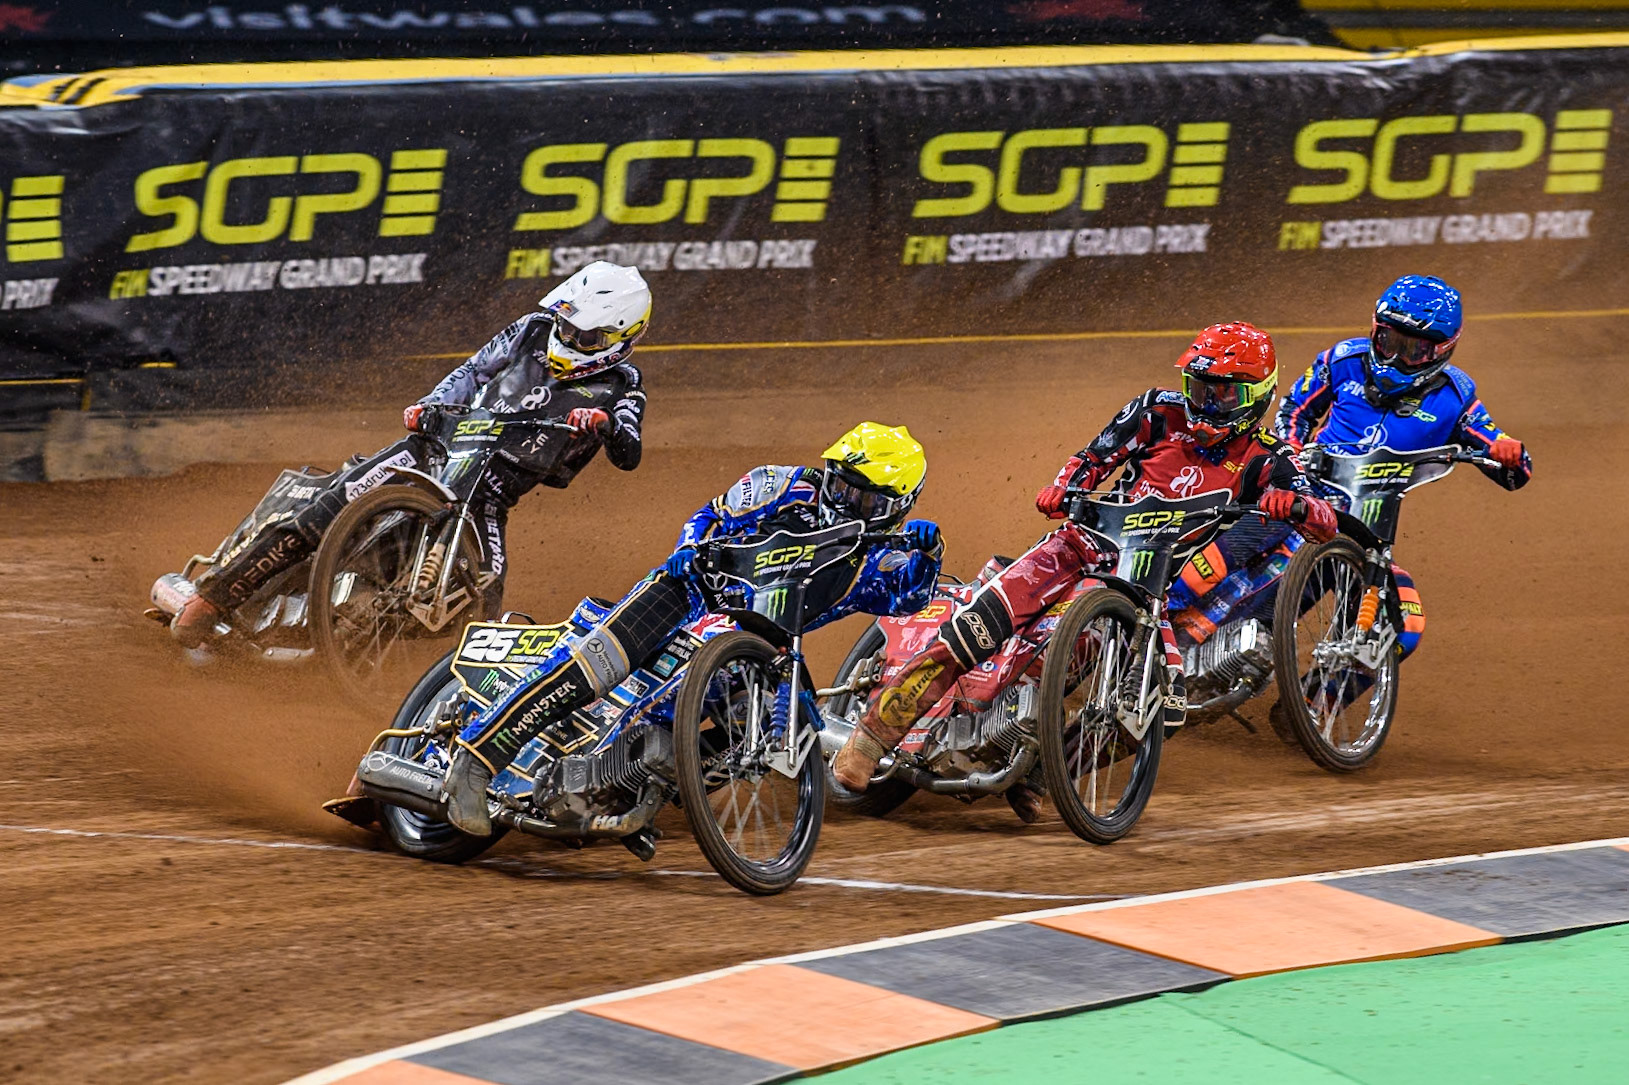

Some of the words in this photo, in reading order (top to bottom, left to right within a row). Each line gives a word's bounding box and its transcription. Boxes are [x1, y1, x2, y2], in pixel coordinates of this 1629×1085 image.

[912, 125, 1168, 217] SGP
[1286, 113, 1546, 203] SGP
[125, 153, 382, 253] SGP
[513, 138, 776, 231] SGP
[948, 229, 1074, 263] SPEEDWAY
[1073, 225, 1154, 257] GRAND
[1155, 223, 1211, 253] PRIX
[1321, 216, 1442, 248] SPEEDWAY
[1442, 212, 1531, 243] GRAND
[1532, 210, 1593, 239] PRIX
[148, 261, 281, 296] SPEEDWAY
[279, 257, 368, 290] GRAND
[366, 253, 428, 285] PRIX
[673, 240, 759, 271] GRAND
[757, 239, 818, 269] PRIX
[2, 278, 60, 310] PRIX
[1122, 511, 1172, 530] SGP
[755, 545, 803, 570] SGP
[460, 628, 521, 662] 25
[512, 681, 577, 736] MONSTER
